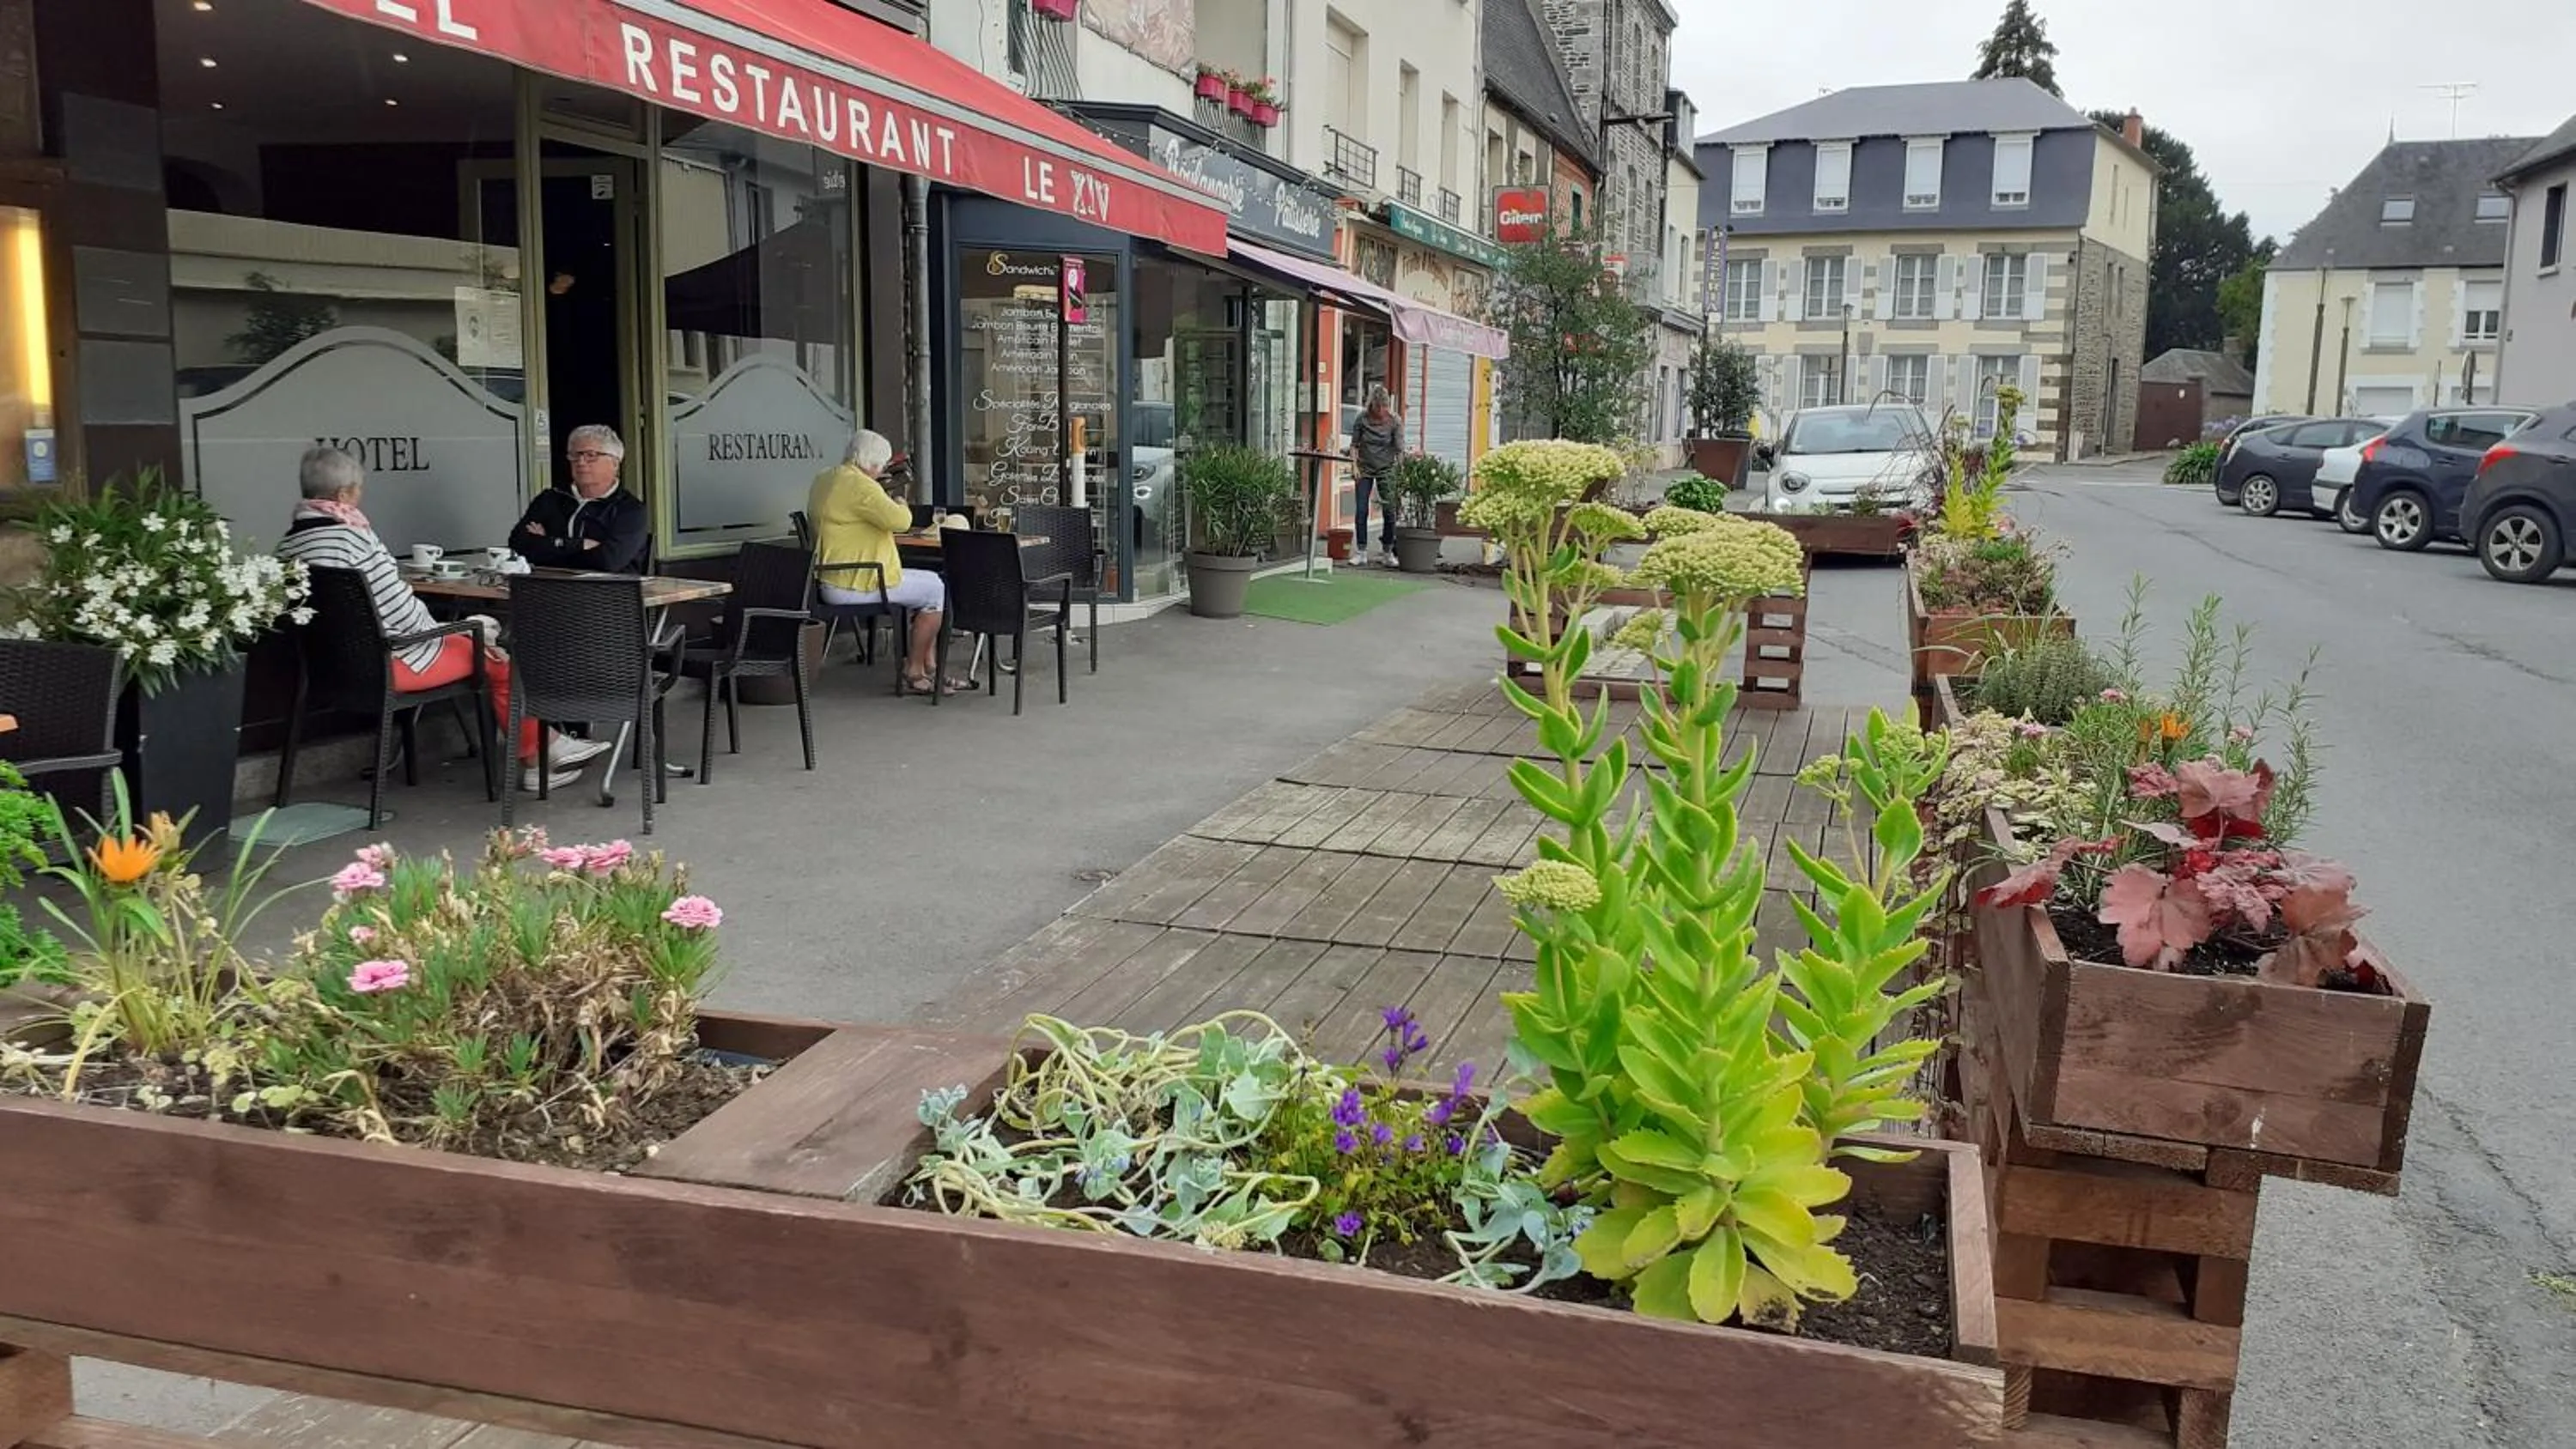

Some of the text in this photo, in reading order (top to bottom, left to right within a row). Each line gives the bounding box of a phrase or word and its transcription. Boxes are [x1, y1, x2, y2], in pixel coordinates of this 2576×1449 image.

[620, 21, 956, 177] RESTAURANT
[1024, 155, 1056, 204] LE
[1070, 169, 1109, 222] XIV
[1499, 209, 1543, 225] Gitem
[315, 437, 430, 471] OTEL
[708, 433, 823, 461] RESTAURAN
